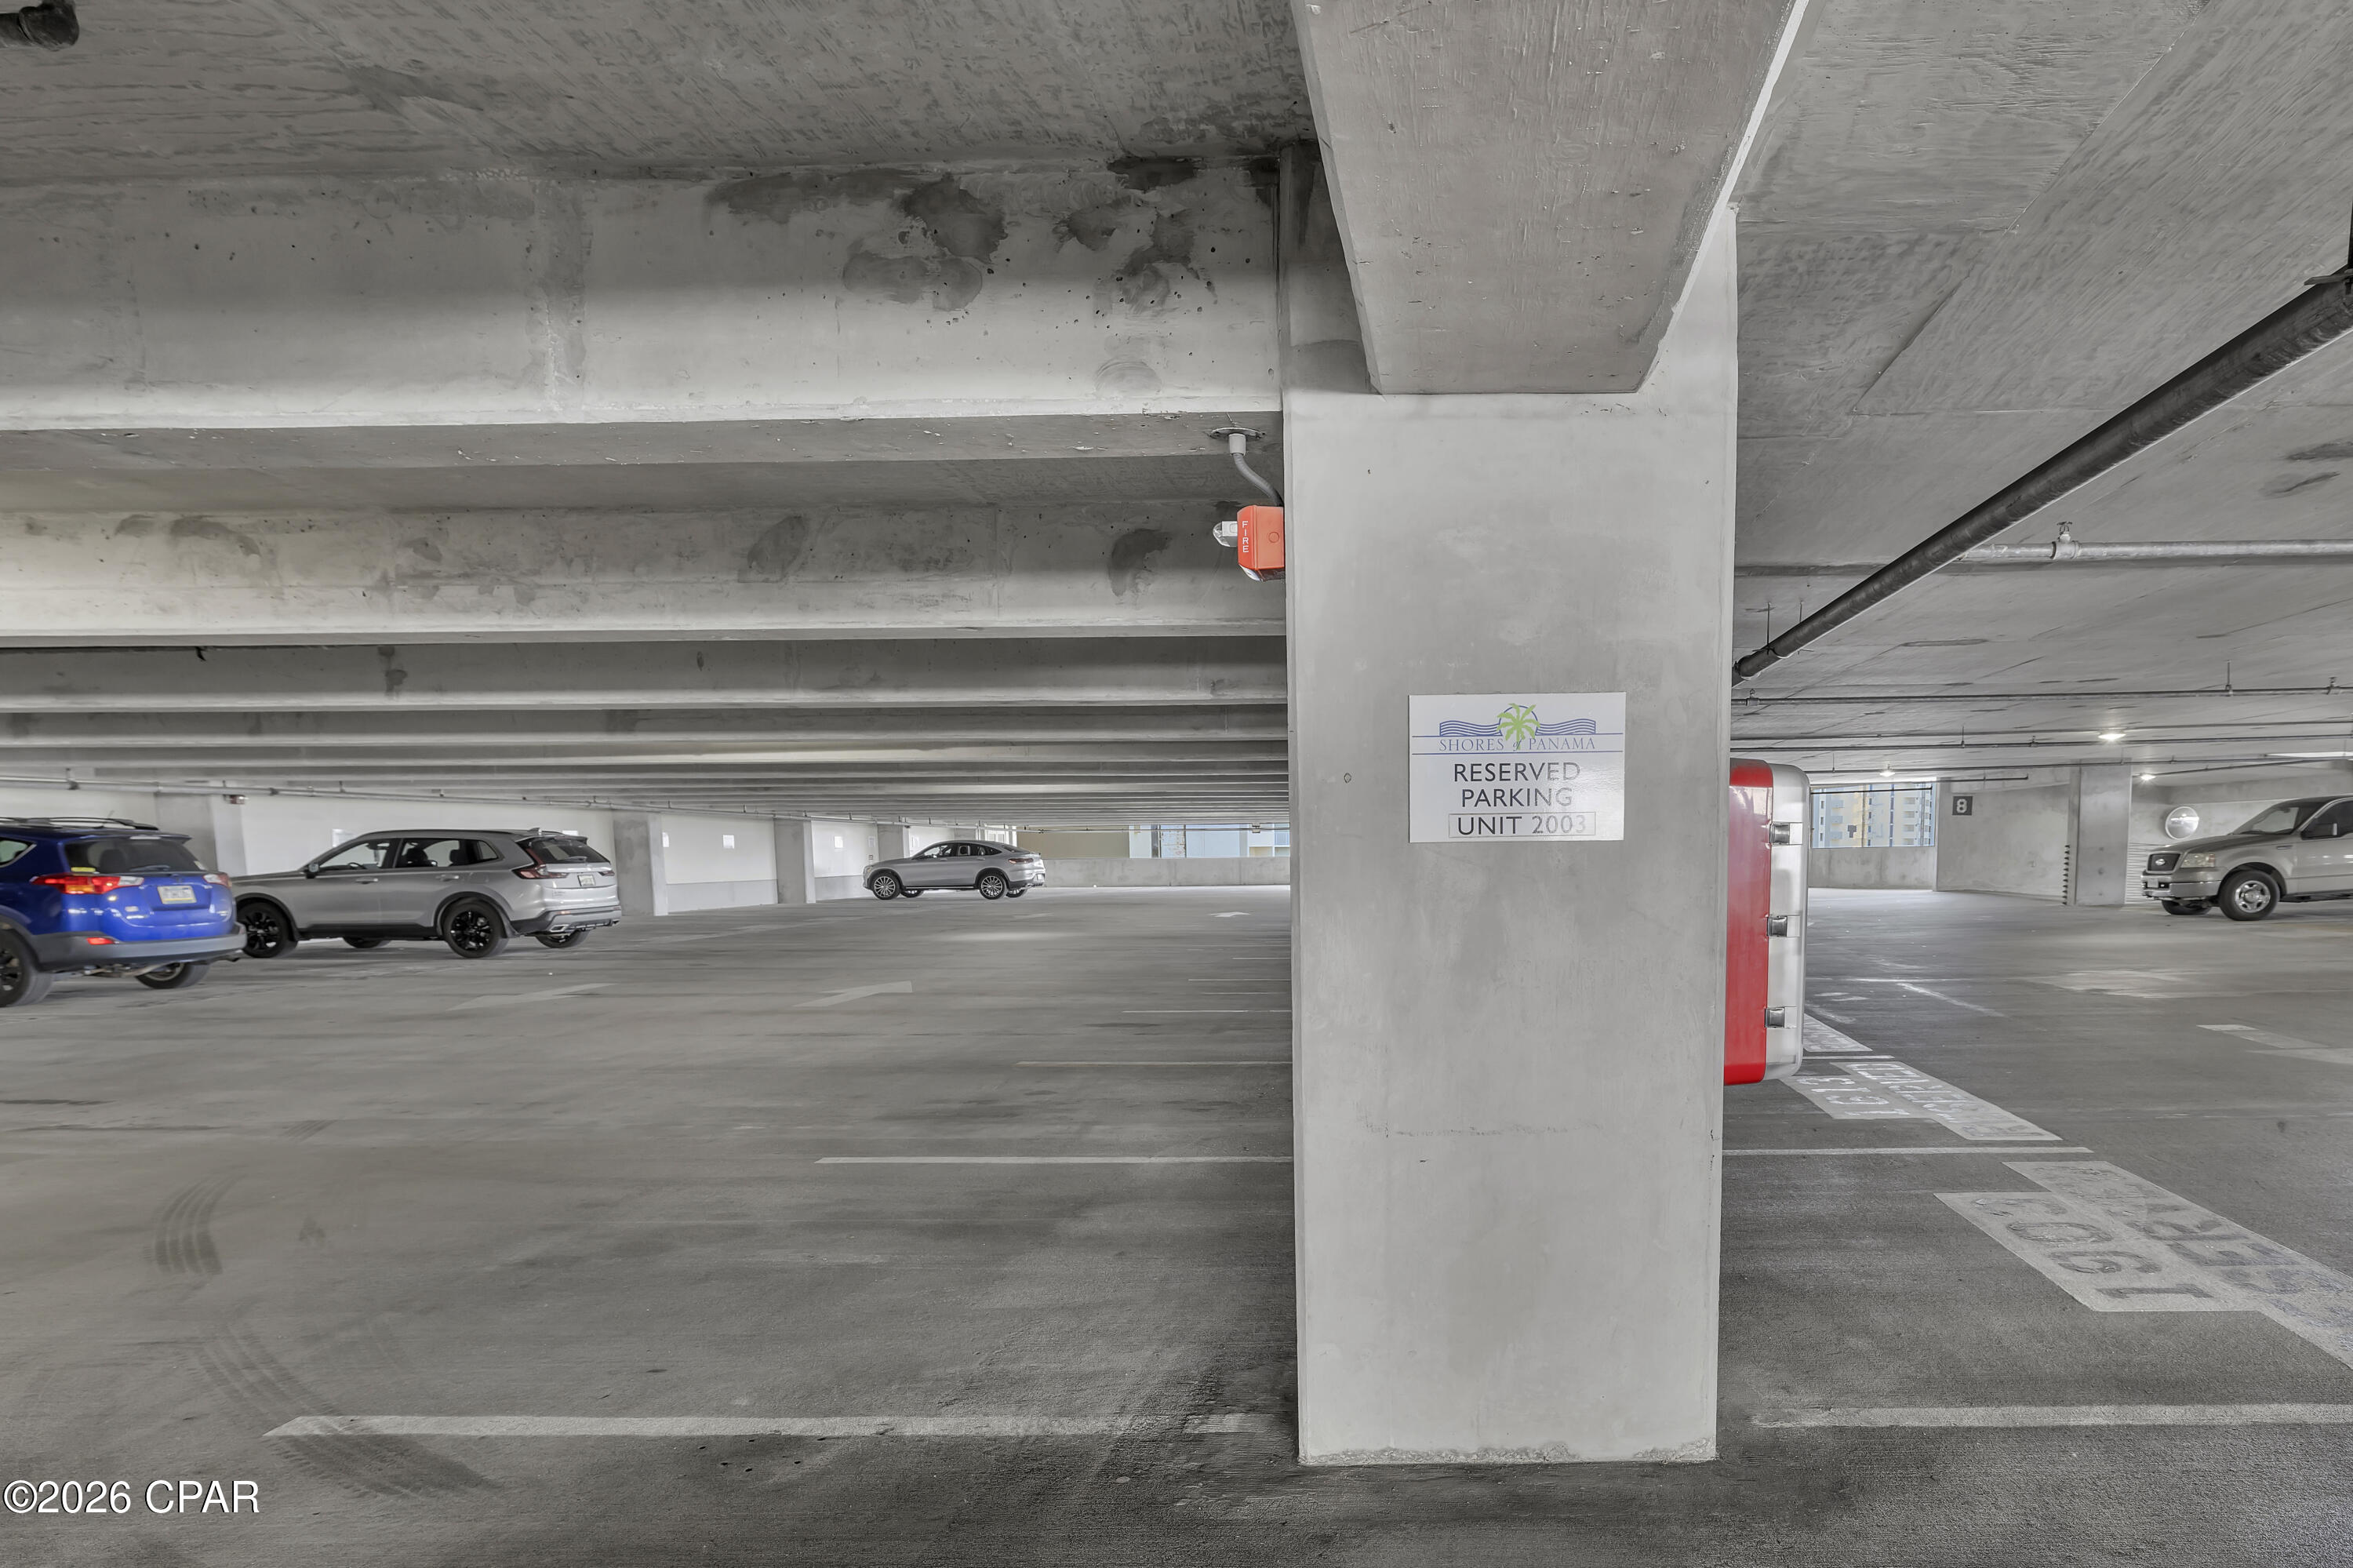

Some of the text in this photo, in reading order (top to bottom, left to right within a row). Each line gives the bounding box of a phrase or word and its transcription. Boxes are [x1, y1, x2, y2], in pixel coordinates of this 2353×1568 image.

[1438, 737, 1596, 751] SHORES of PANAMA
[1454, 762, 1580, 782] RESERVED
[1461, 787, 1573, 807] PARKING
[1458, 815, 1586, 835] UNIT 2003
